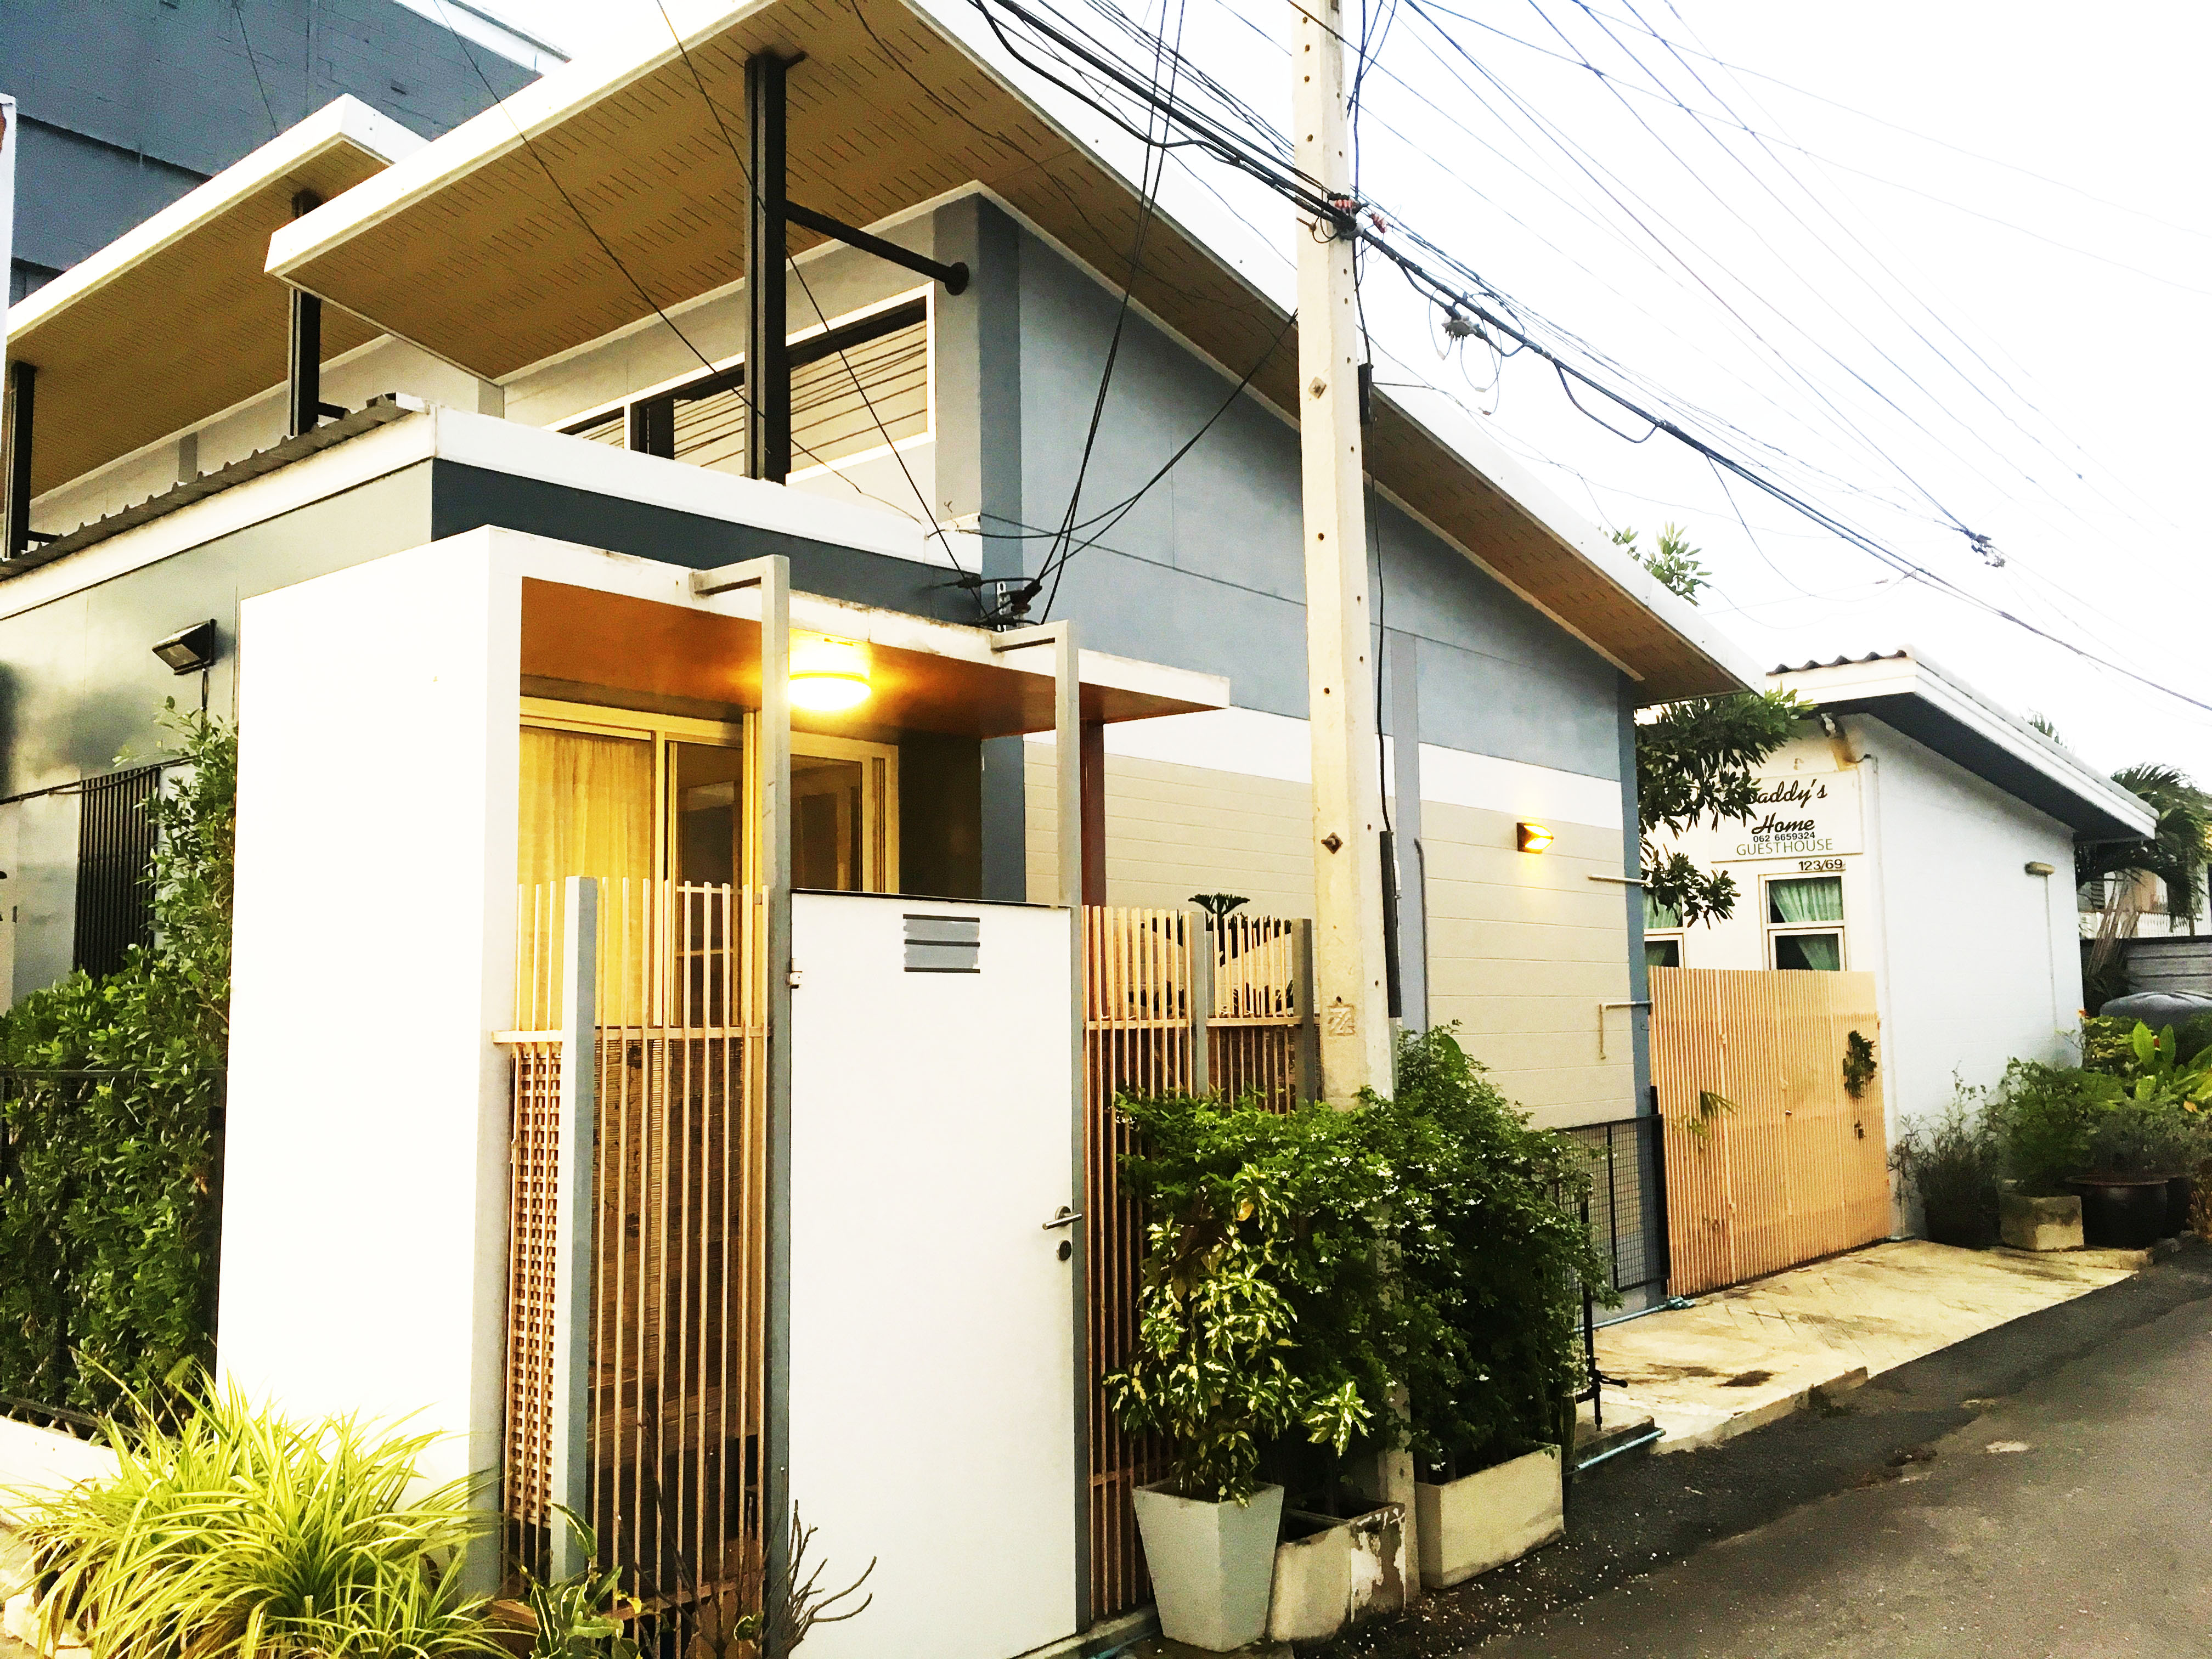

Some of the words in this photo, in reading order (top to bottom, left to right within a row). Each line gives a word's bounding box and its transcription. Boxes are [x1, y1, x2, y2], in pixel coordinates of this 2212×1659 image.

[1751, 812, 1815, 834] Home
[1753, 834, 1770, 843] 062
[1774, 831, 1815, 841] 6659324
[1798, 859, 1843, 871] 123/69
